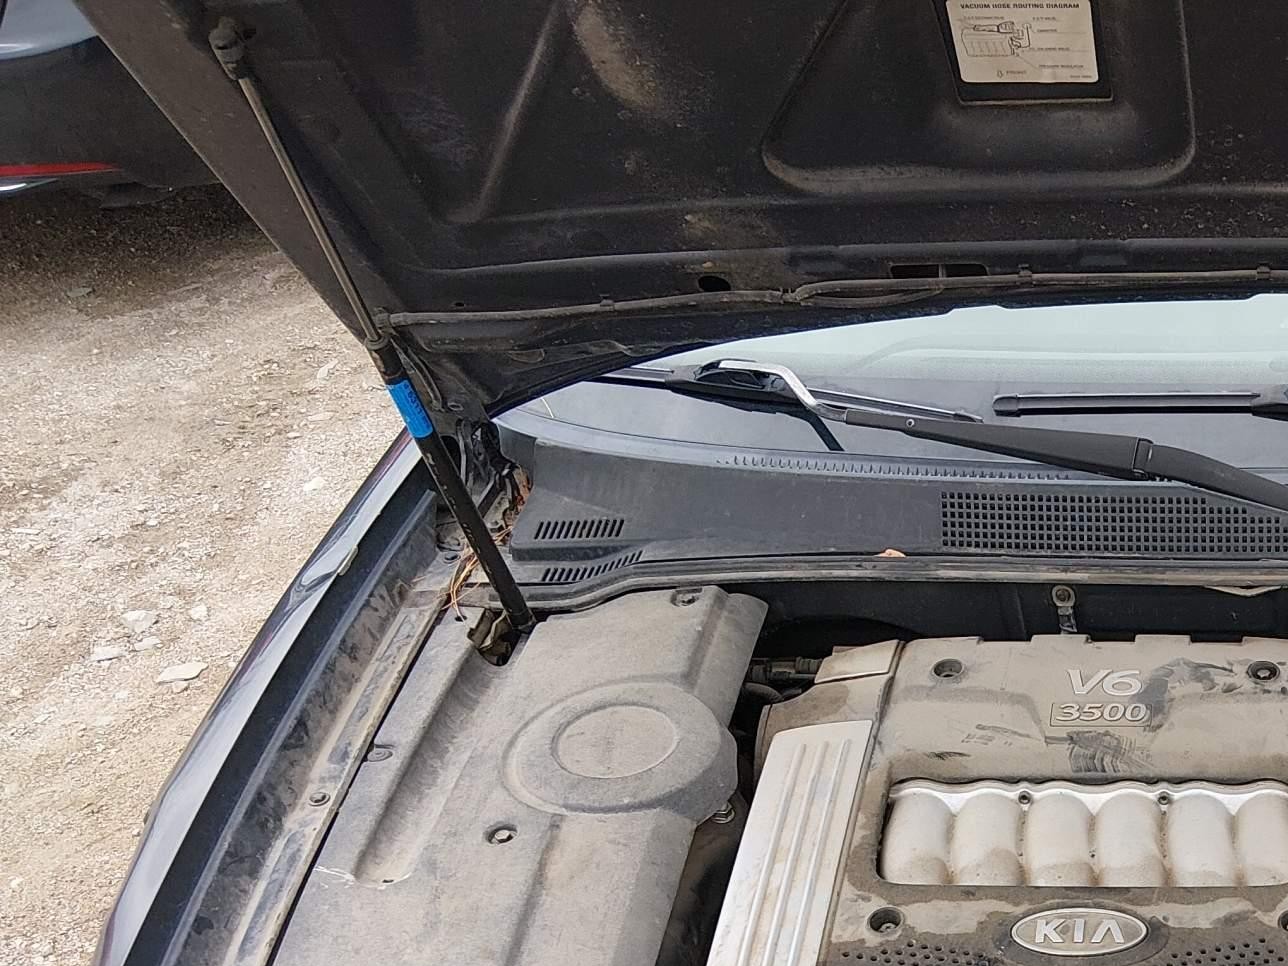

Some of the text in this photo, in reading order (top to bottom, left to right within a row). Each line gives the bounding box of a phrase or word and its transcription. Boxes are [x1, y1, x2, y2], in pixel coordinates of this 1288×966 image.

[1066, 669, 1143, 696] V6
[1055, 703, 1148, 721] 3500
[1035, 918, 1125, 943] KIA
